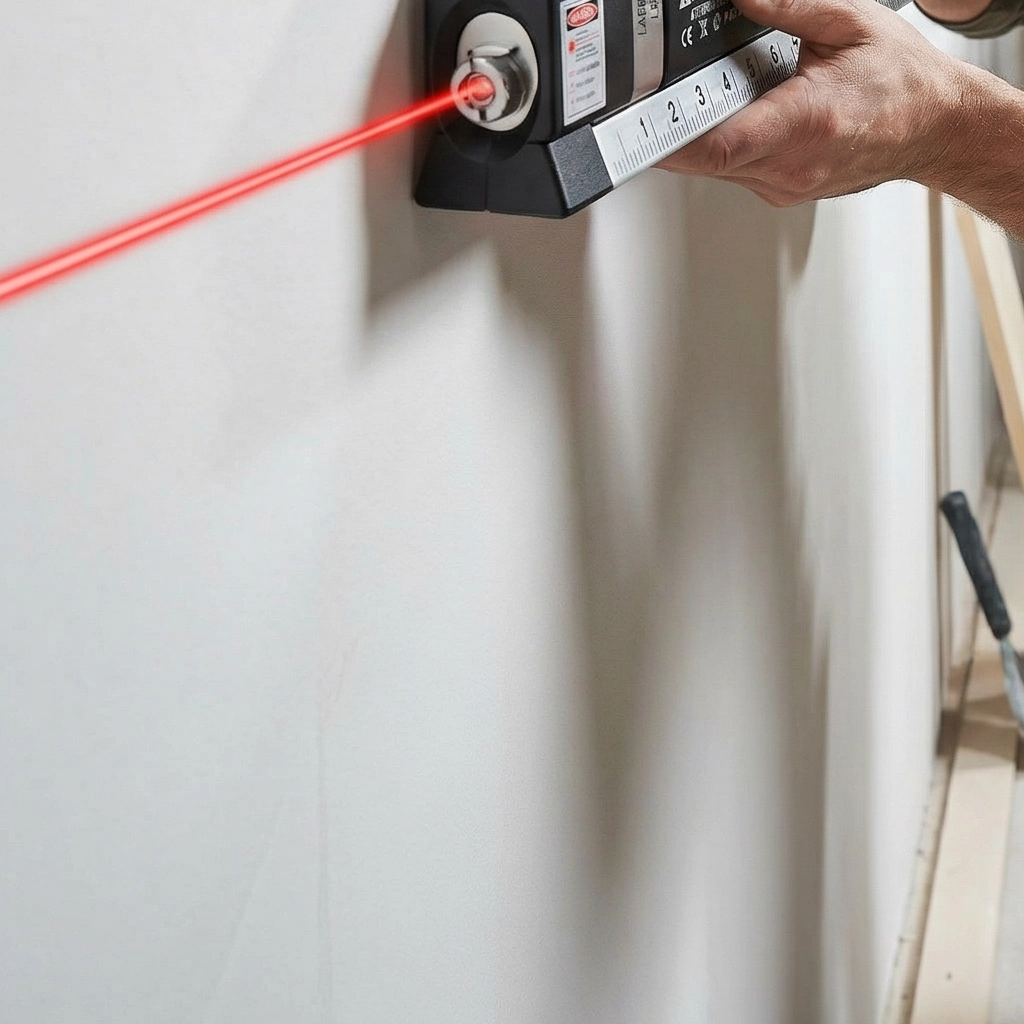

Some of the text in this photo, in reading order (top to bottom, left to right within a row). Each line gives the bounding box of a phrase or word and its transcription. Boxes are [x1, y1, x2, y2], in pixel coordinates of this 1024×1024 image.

[640, 44, 780, 138] 1 2 3 4 5 6
